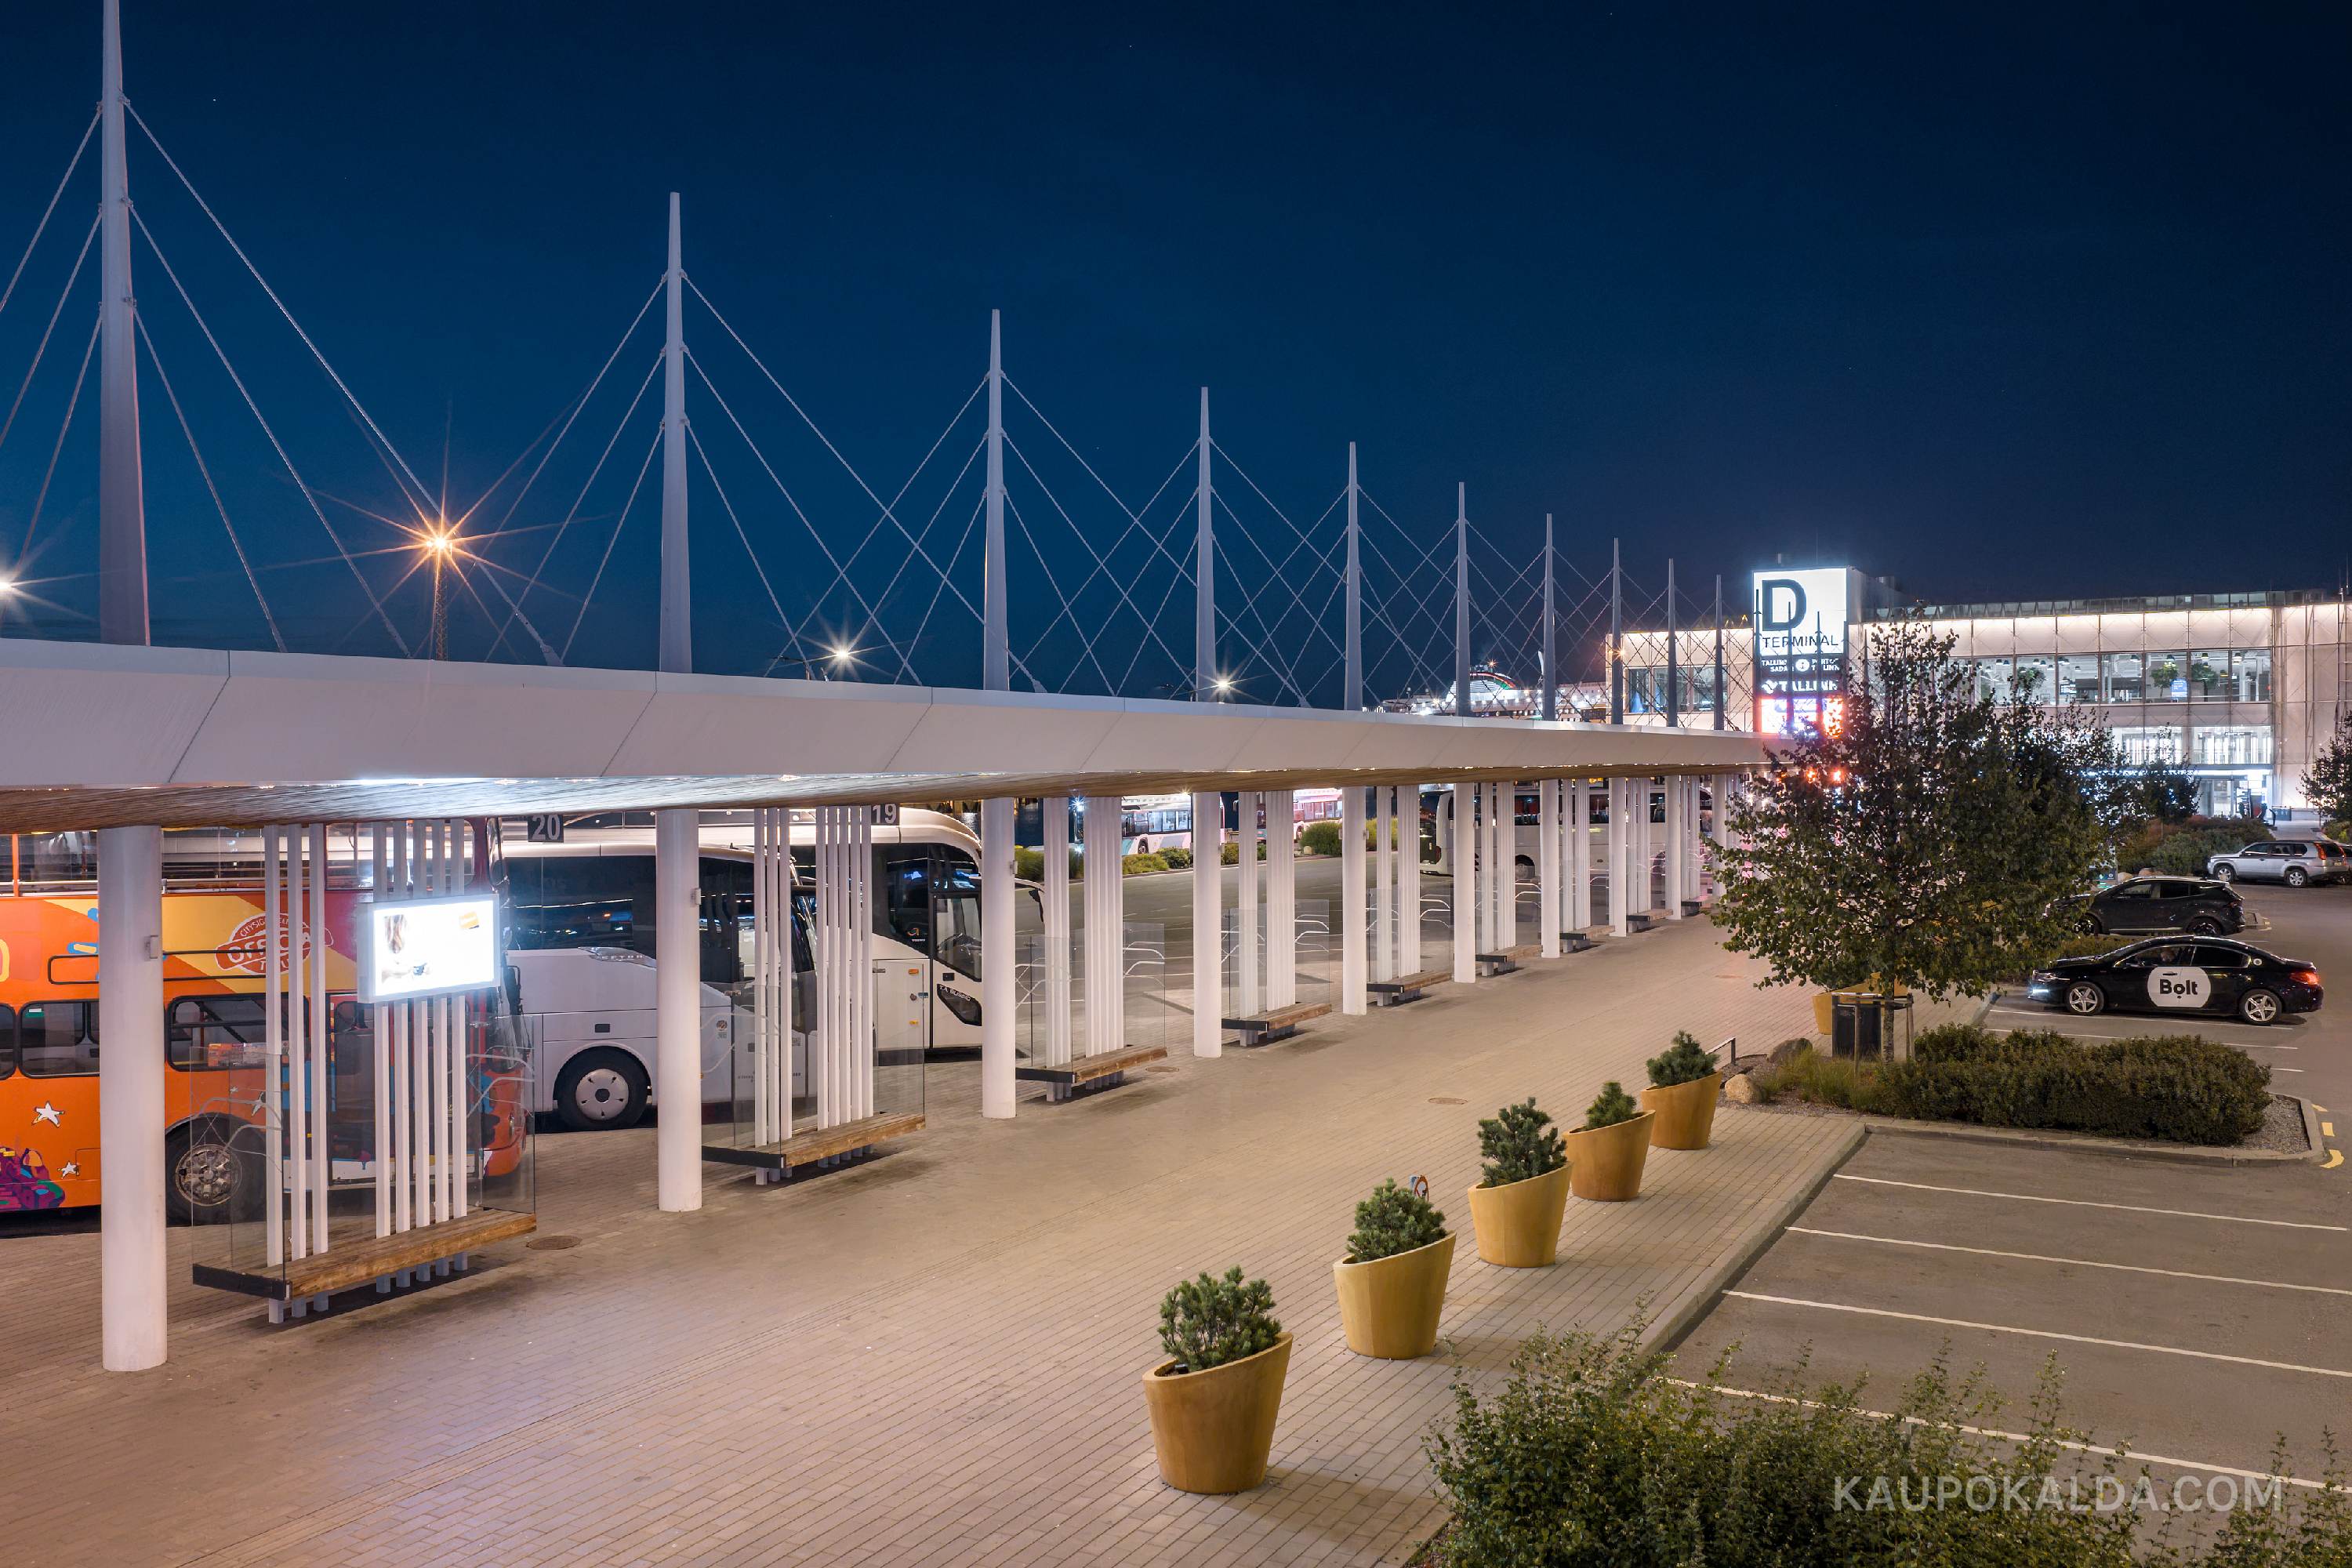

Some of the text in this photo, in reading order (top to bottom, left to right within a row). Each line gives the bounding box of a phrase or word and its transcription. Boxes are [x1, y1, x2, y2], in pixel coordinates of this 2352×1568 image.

[1762, 579, 1807, 632] D
[1762, 635, 1838, 648] TERMINAL
[872, 803, 898, 824] 19
[532, 814, 561, 840] 20
[2159, 978, 2198, 1000] Bolt
